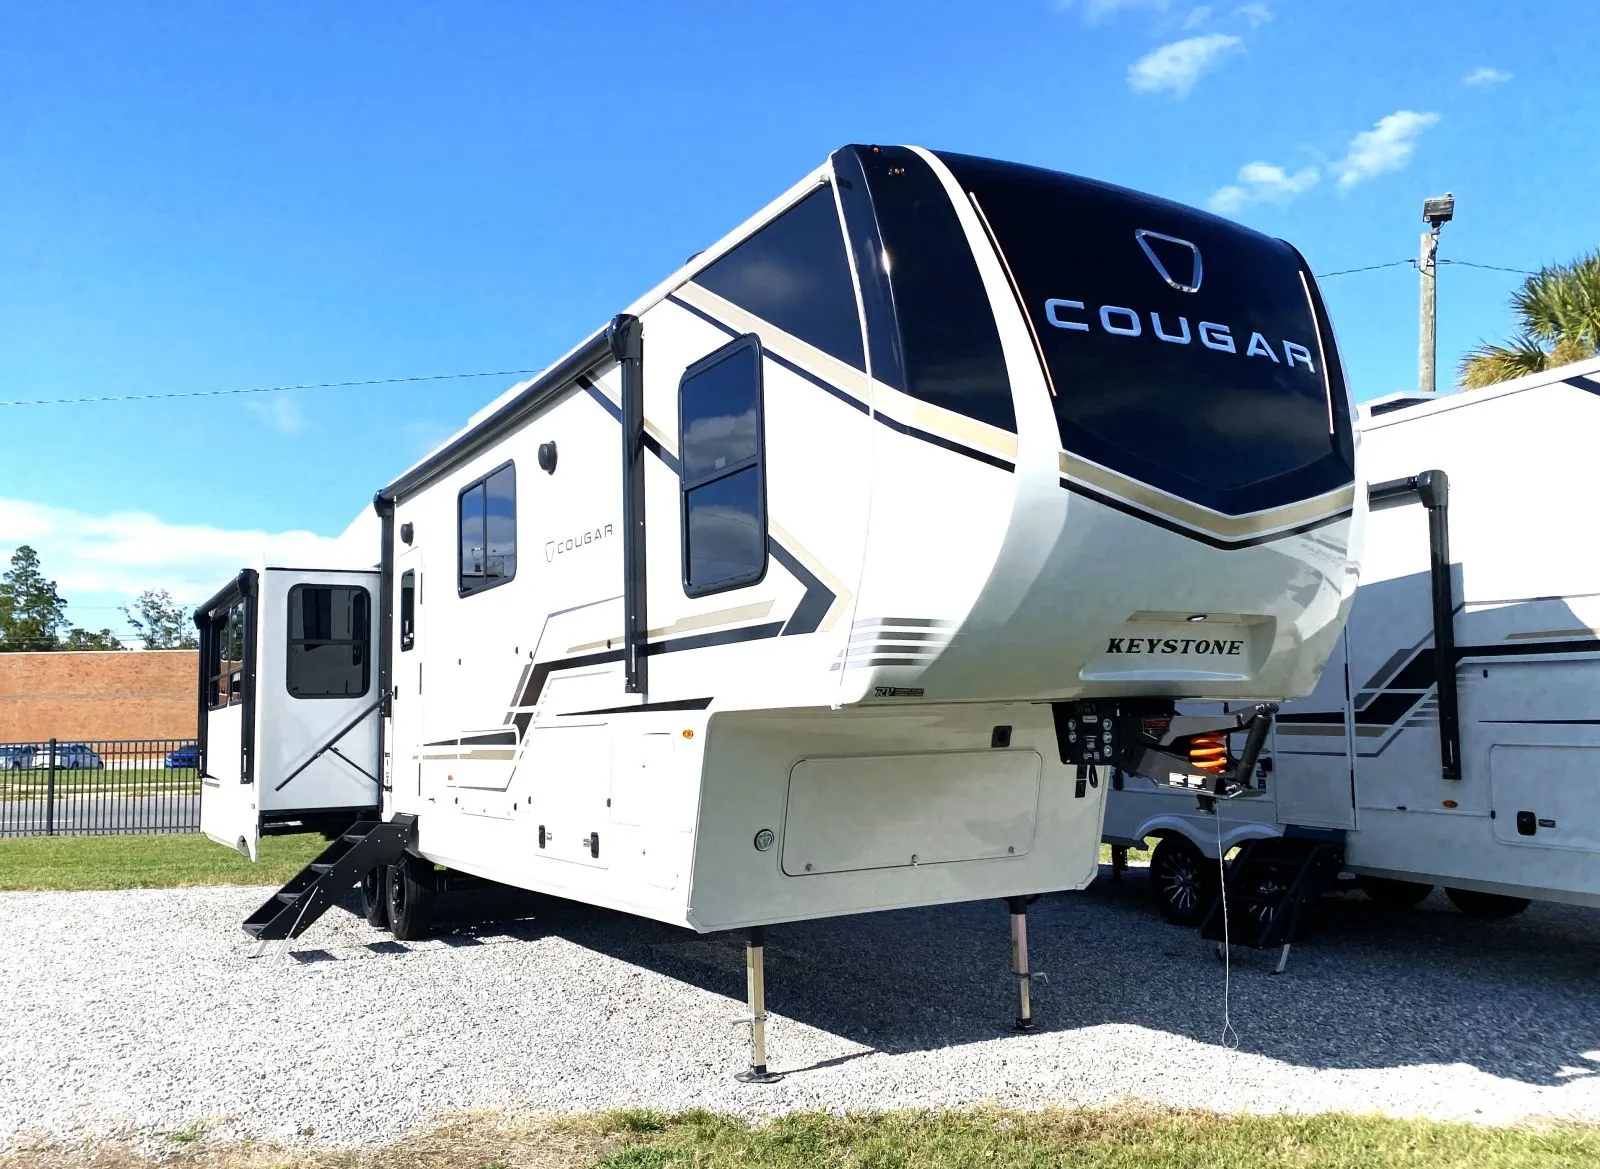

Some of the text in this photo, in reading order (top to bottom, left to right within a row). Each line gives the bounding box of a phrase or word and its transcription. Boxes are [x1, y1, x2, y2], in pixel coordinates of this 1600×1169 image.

[1045, 299, 1315, 373] COUGAR
[557, 524, 613, 554] COUGAR
[1106, 638, 1243, 655] KEYSTONE
